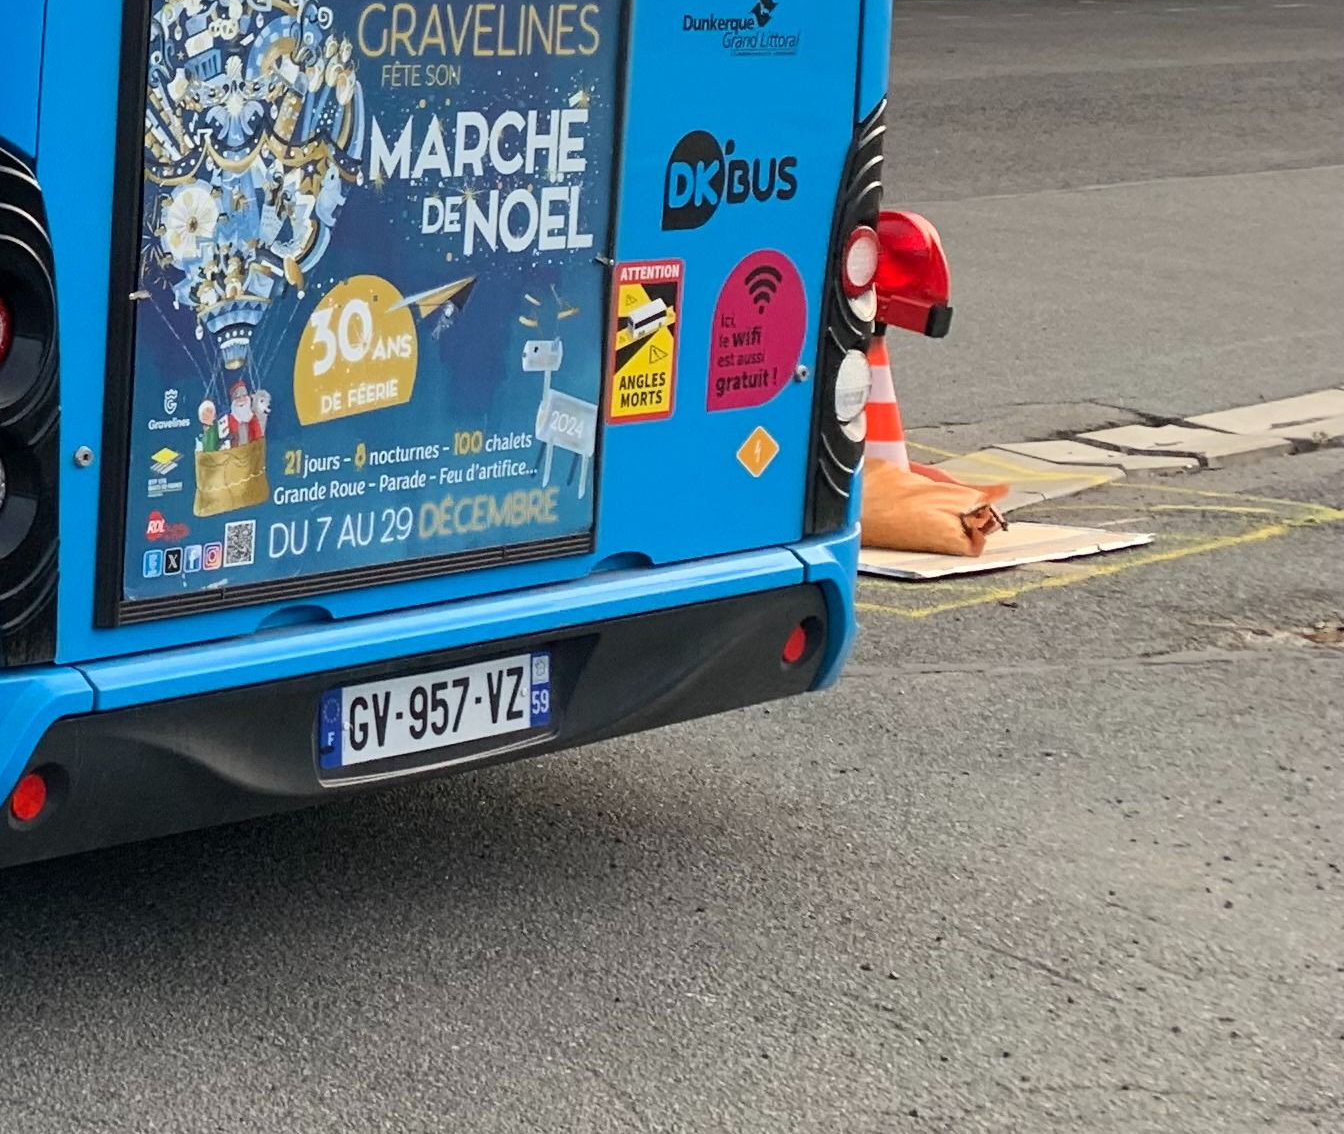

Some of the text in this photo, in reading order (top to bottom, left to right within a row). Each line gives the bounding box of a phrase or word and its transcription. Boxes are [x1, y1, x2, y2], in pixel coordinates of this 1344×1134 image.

[358, 2, 601, 58] GRAVELINES
[683, 13, 755, 34] Dunkerque
[722, 30, 759, 50] Grand
[381, 61, 461, 87] FÊTE SON
[368, 90, 589, 181] MARCHÉ
[421, 196, 463, 234] DE
[620, 263, 680, 281] ATTENTION
[310, 299, 413, 376] 30 ANS
[732, 326, 762, 348] wifi
[717, 349, 766, 368] est aussi
[619, 372, 666, 392] ANGLES
[715, 368, 770, 398] gratuit
[620, 390, 663, 409] MORTS
[148, 417, 191, 430] Gravelines
[549, 411, 585, 439] 2024
[283, 449, 301, 476] 21
[302, 454, 341, 478] jours
[369, 445, 440, 467] nocturnes
[452, 430, 483, 456] 100
[485, 432, 533, 453] chalets
[273, 485, 327, 506] Grande
[329, 479, 366, 499] Roue
[379, 471, 427, 494] Parade
[439, 467, 464, 486] Feu
[146, 518, 165, 534] RDL
[268, 486, 561, 558] DU 7 AU 29 DÉCEMBRE
[326, 666, 550, 752] F GV-957-VZ 59
